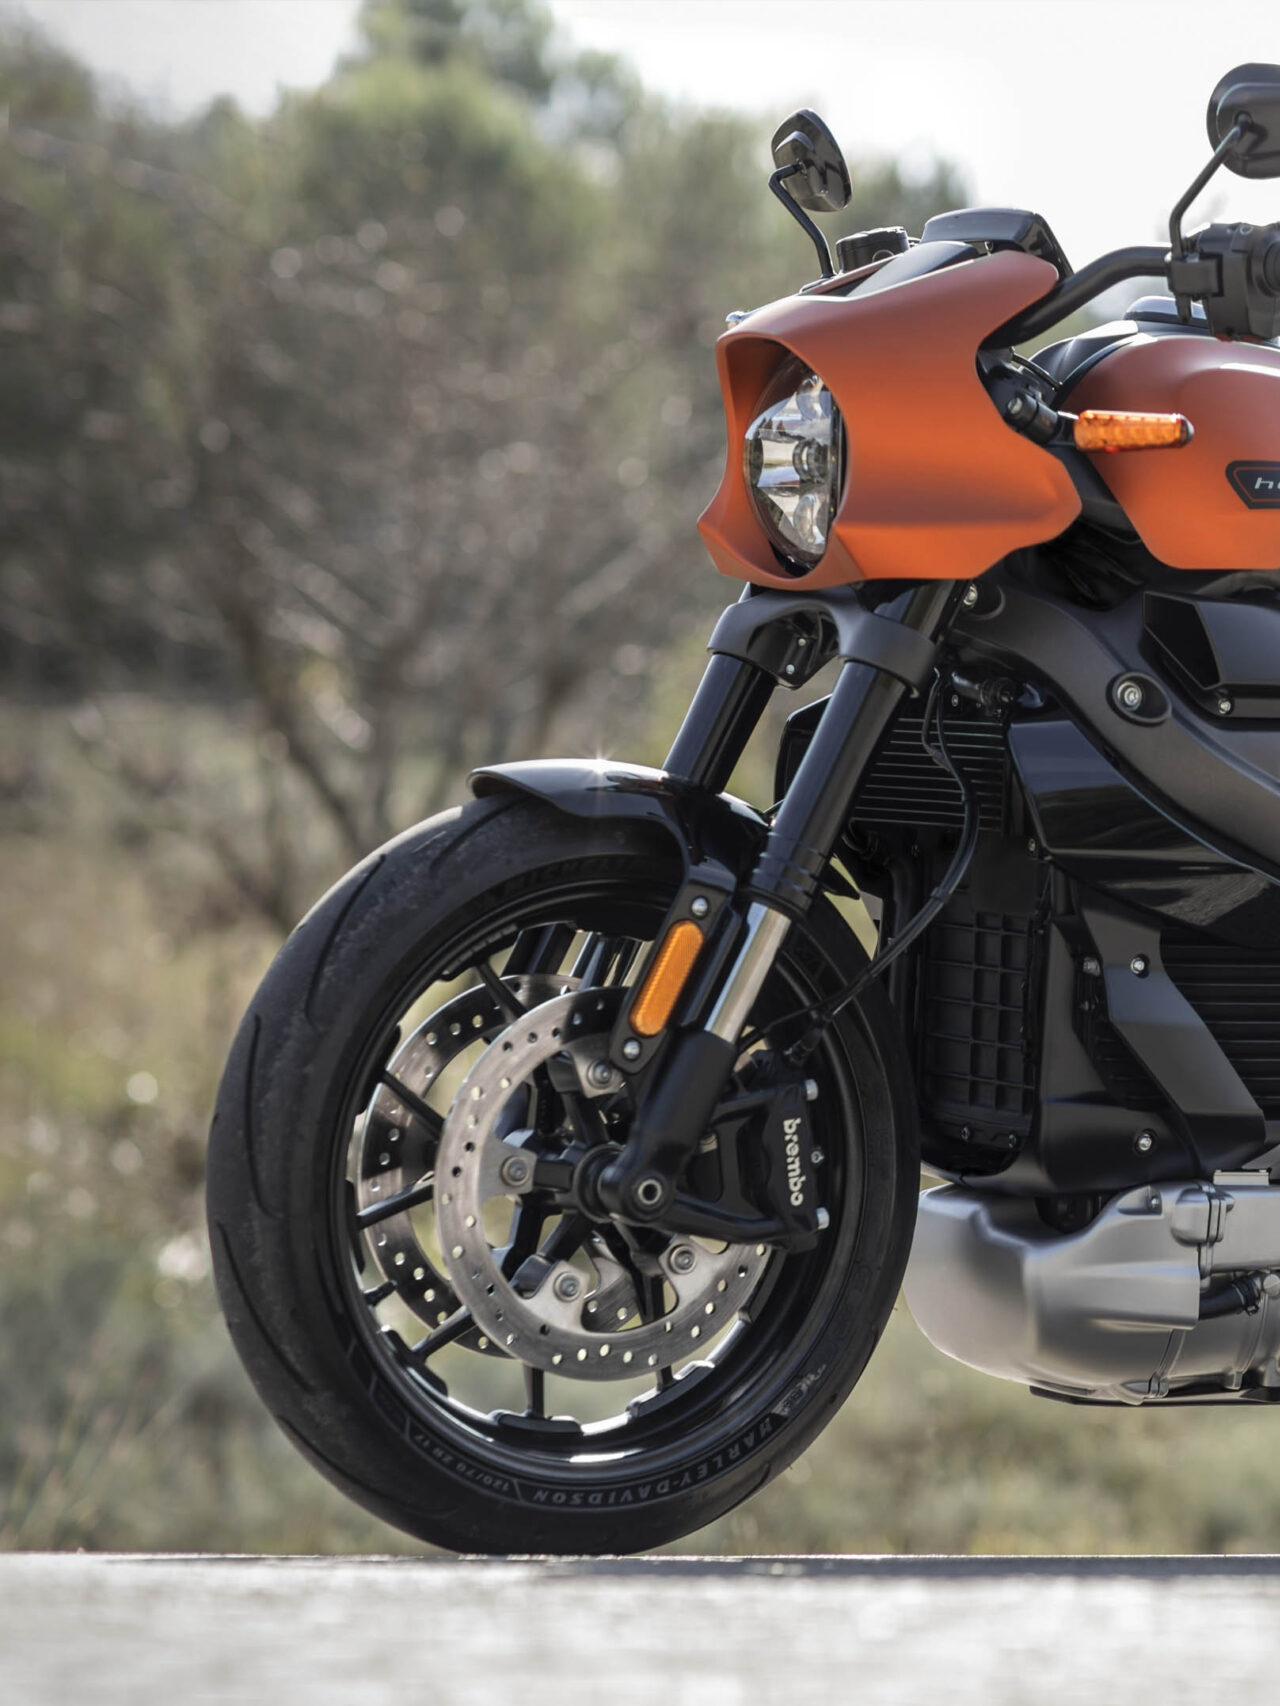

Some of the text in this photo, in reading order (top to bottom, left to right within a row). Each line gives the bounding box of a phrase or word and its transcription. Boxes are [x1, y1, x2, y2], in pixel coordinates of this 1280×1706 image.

[783, 1117, 806, 1207] brembo
[413, 1417, 779, 1505] HARLEY-DAVIDSON 120/70 ZR 17
